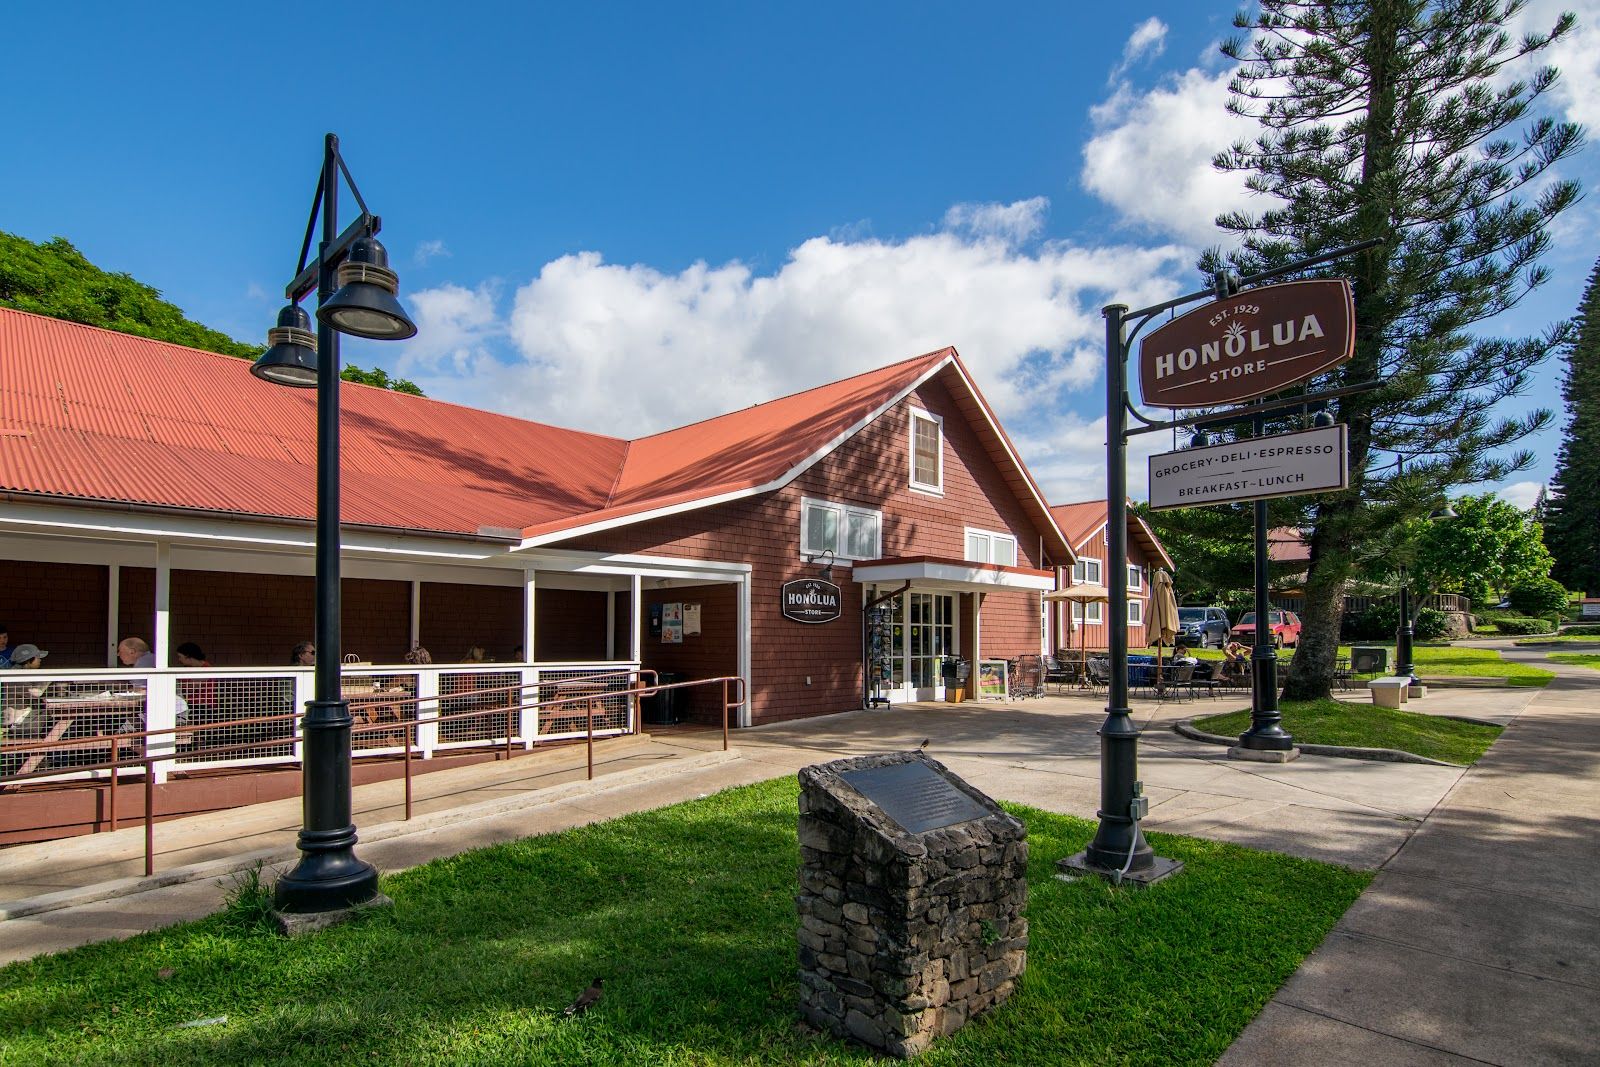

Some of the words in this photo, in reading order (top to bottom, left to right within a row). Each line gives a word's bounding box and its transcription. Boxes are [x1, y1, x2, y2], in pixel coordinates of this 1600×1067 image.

[1209, 309, 1231, 327] EST.
[1233, 304, 1260, 315] 1929
[1155, 314, 1325, 379] HONOLUA
[1208, 359, 1266, 383] STORE
[1155, 457, 1213, 478] GROCERY
[1221, 452, 1250, 463] DELI
[1259, 445, 1333, 458] ESPRESSO
[1178, 480, 1249, 497] BREAKFAST
[1258, 473, 1305, 487] LUNCH
[788, 593, 836, 606] HONOLUA
